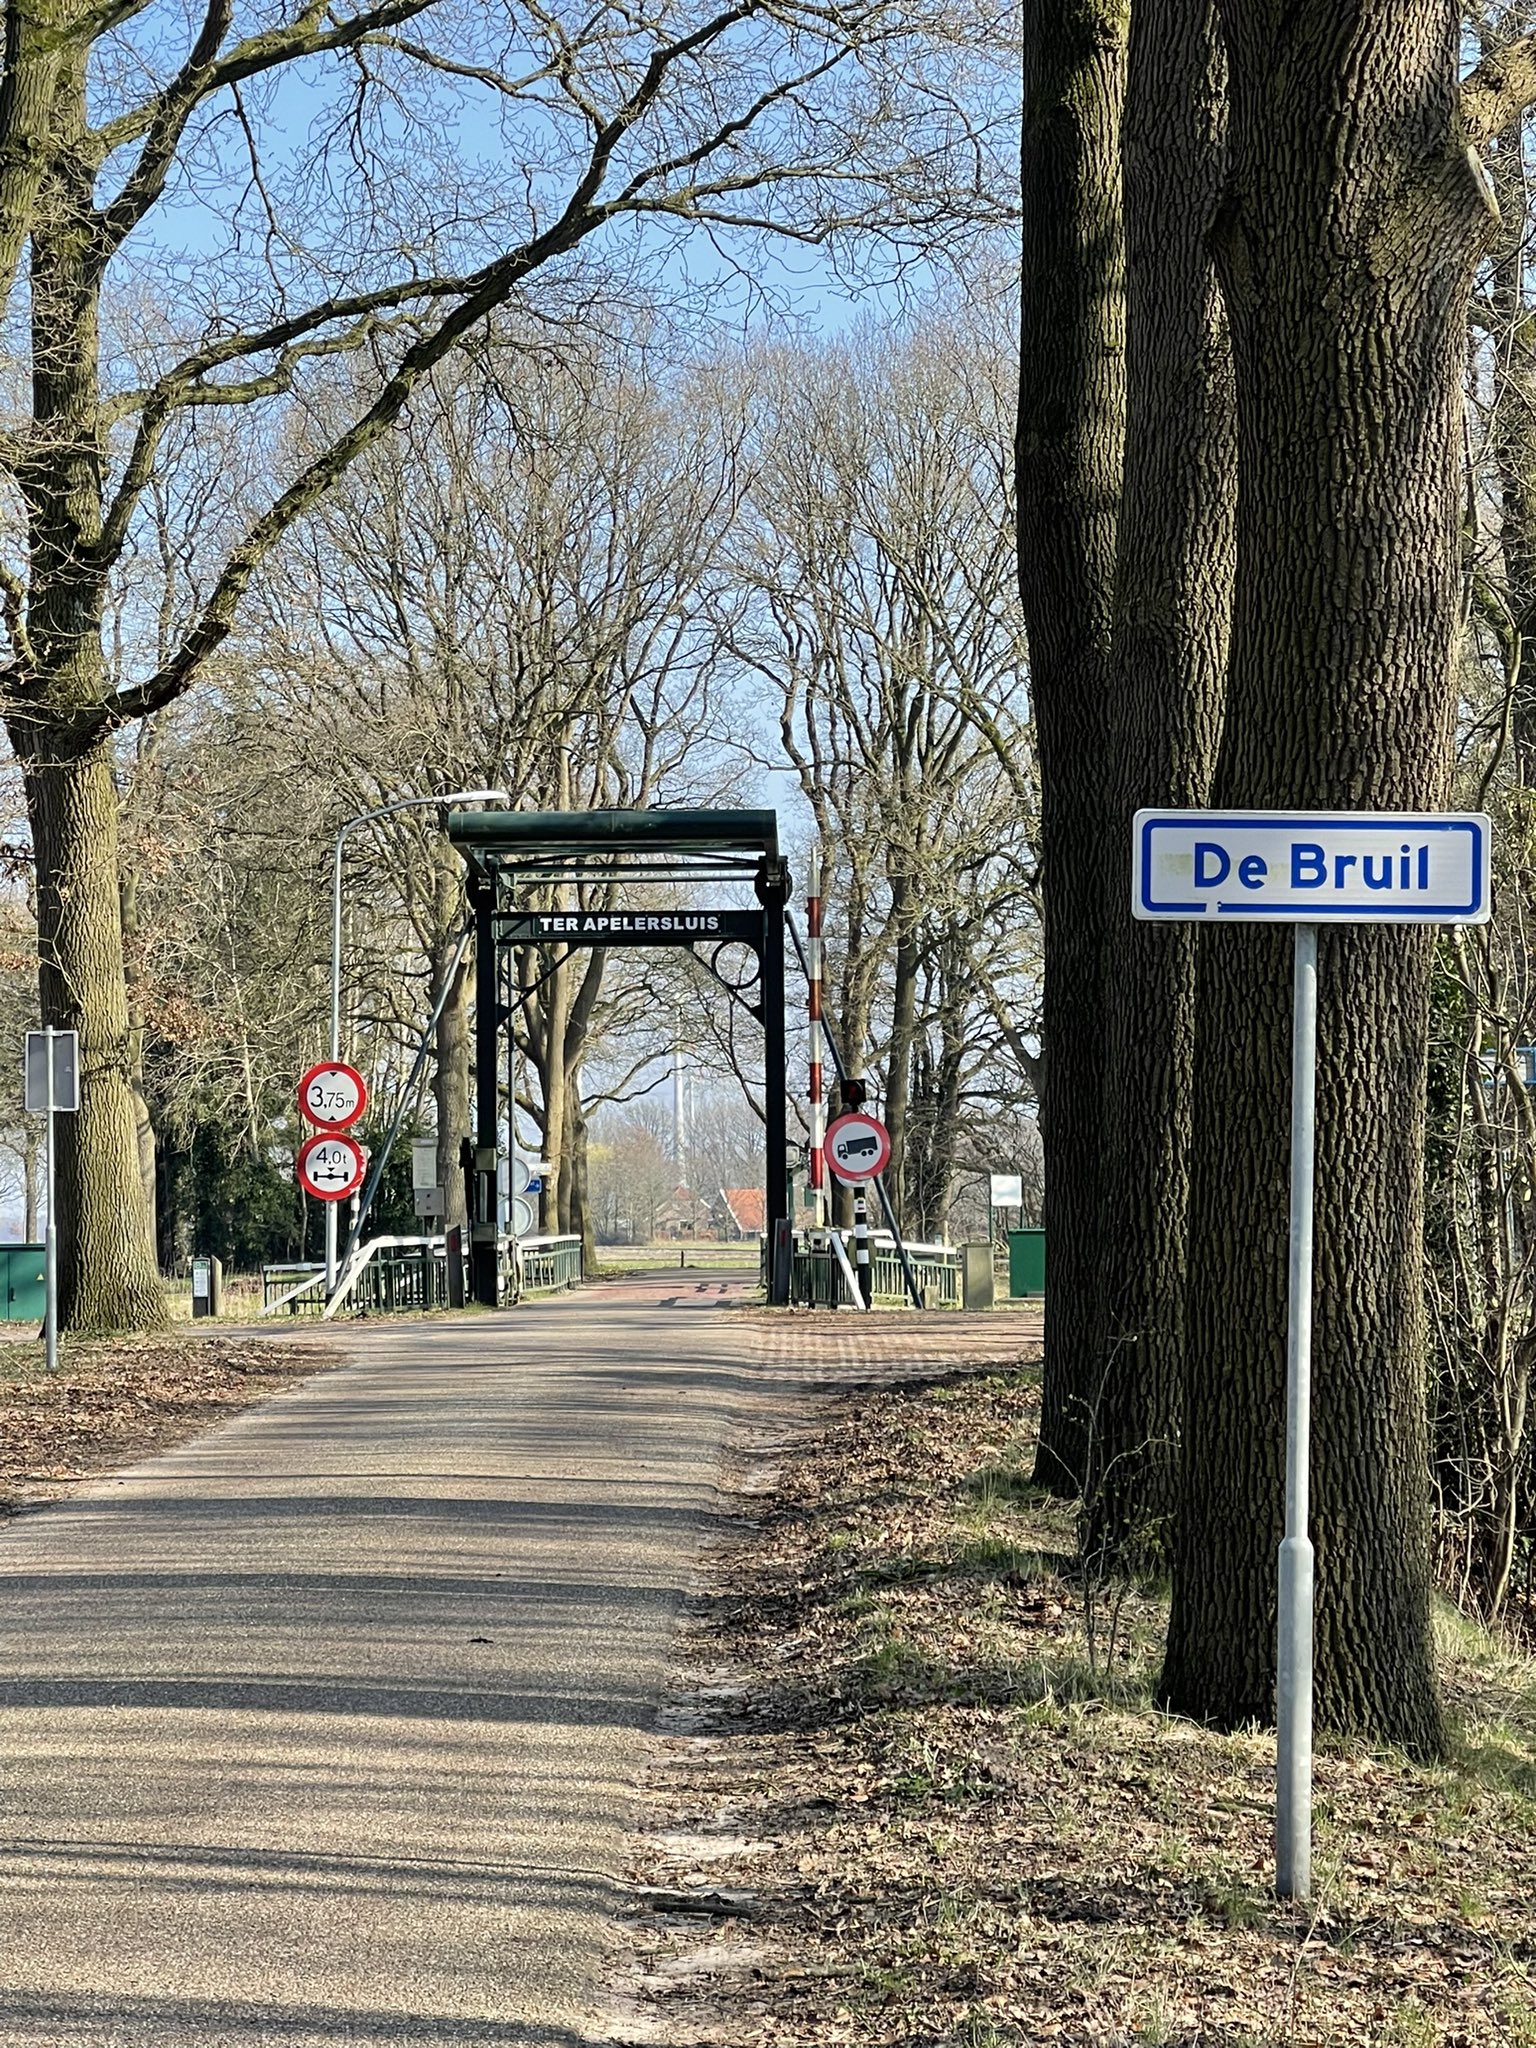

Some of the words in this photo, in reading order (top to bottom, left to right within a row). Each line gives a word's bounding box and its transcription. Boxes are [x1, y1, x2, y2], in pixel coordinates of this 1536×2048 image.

[1194, 842, 1268, 889] De
[1290, 843, 1429, 890] Bruil
[539, 917, 579, 932] TER
[583, 916, 719, 931] APELERSLUIS
